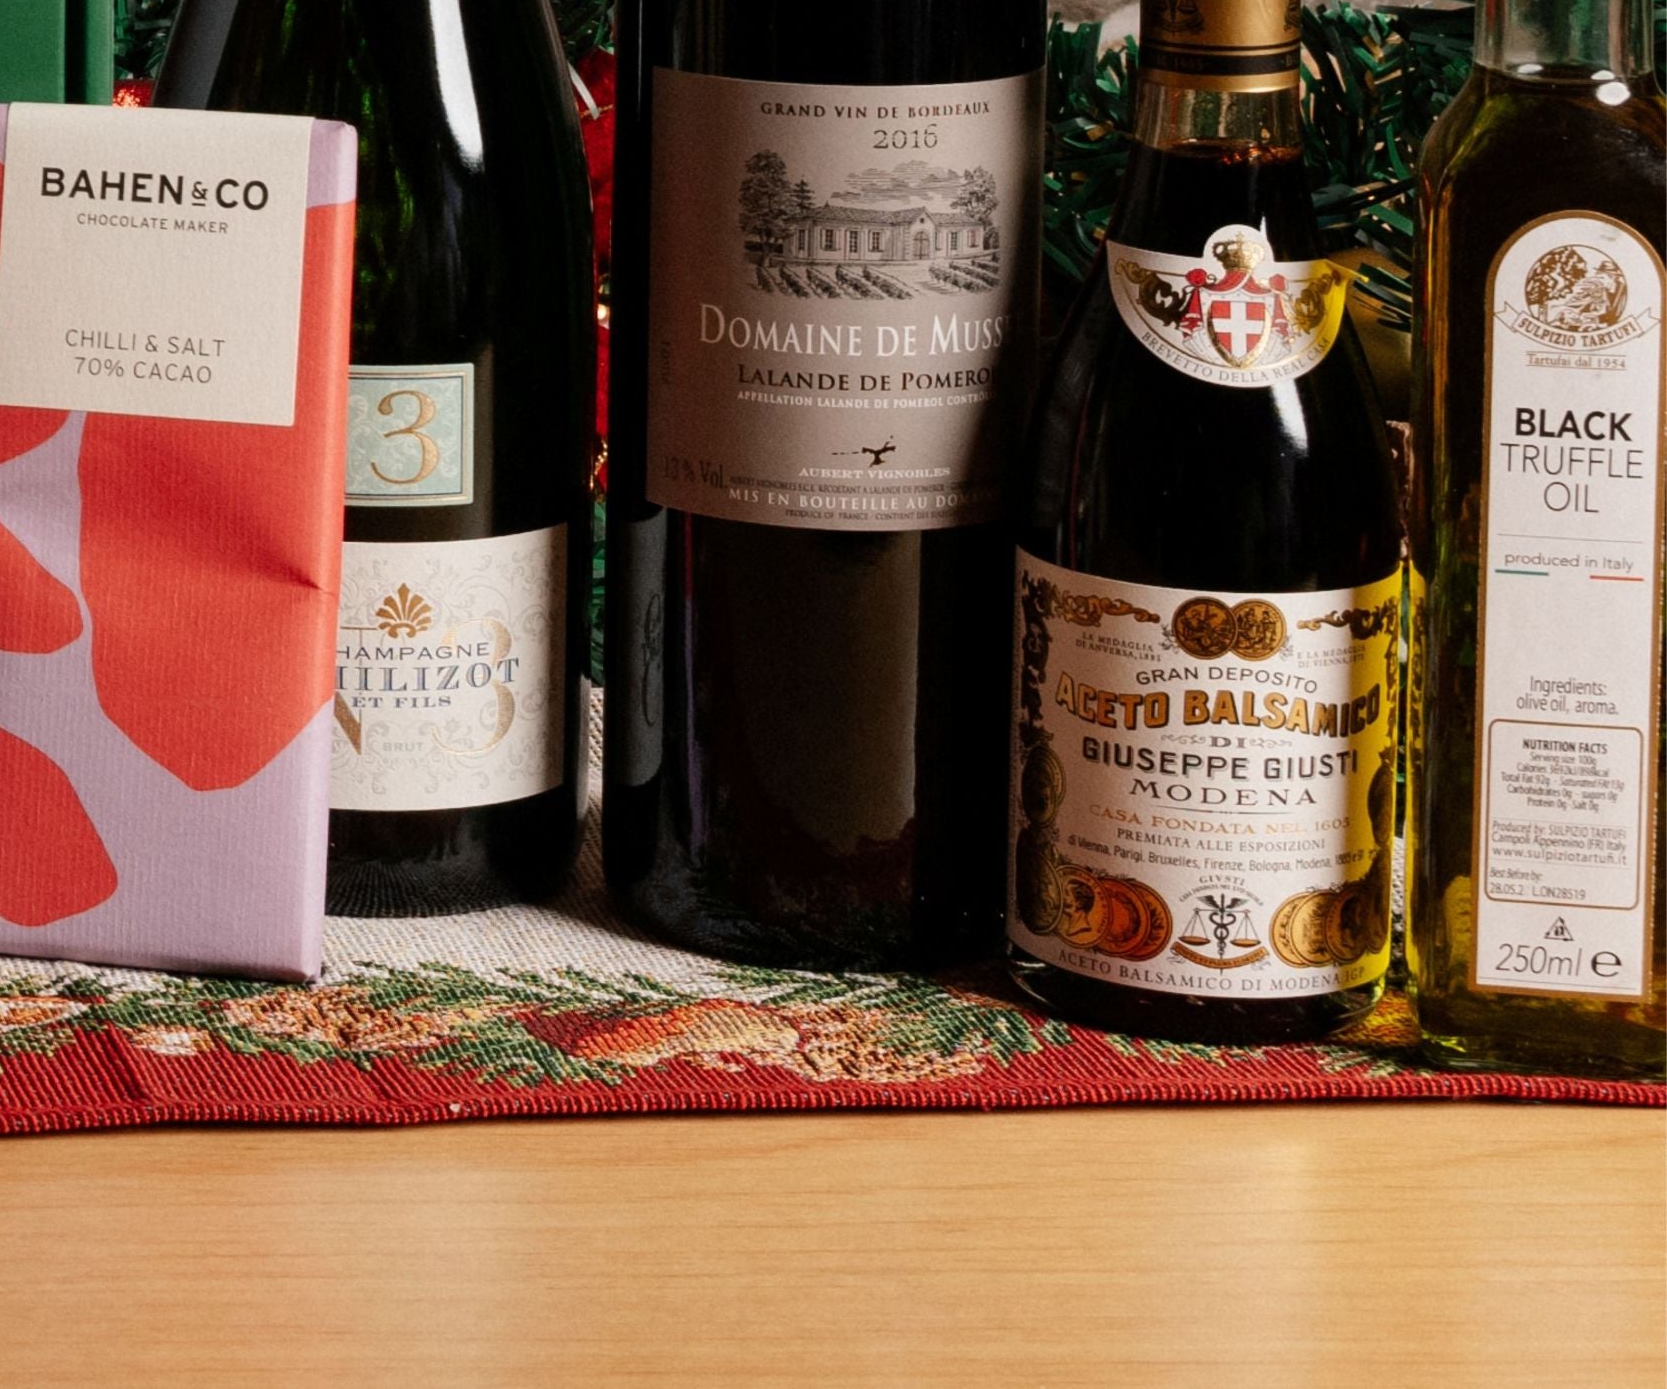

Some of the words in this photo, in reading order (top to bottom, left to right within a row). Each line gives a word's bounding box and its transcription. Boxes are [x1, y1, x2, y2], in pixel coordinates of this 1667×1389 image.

[760, 101, 826, 119] GRAND
[834, 105, 868, 119] VIN
[877, 106, 899, 119] DE
[907, 101, 991, 119] BORDEAUX
[872, 124, 939, 150] 2016
[76, 212, 168, 231] CHOCOLATE
[173, 219, 229, 235] MAKER
[64, 329, 137, 351] CHILLI
[144, 334, 159, 353] &
[166, 335, 227, 358] SALT
[875, 324, 917, 357] DE
[928, 312, 1014, 356] MUSS
[72, 356, 125, 379] 70%
[132, 361, 213, 384] CACAO
[370, 389, 441, 485] 3
[1514, 406, 1633, 442] BLACK
[1499, 441, 1645, 480] TRUFFLE
[1543, 481, 1600, 514] OIL
[335, 641, 491, 661] HAMPAGNE
[335, 657, 520, 692] ILIZOT
[1135, 666, 1199, 685] GRAN
[1208, 666, 1319, 695] DEPOSITO
[1530, 675, 1608, 697] Ingredients:
[351, 696, 383, 709] ET
[394, 695, 453, 709] FILS
[1055, 671, 1170, 730] ACETO
[1182, 682, 1382, 739] BALSAMICO
[1081, 736, 1248, 780] GIUSEPPE
[1262, 749, 1359, 780] GIUSTI
[1522, 737, 1576, 753] NUTRITION
[1578, 742, 1609, 755] FACTS
[1128, 778, 1318, 807] MODENA
[1495, 942, 1584, 977] 250ml
